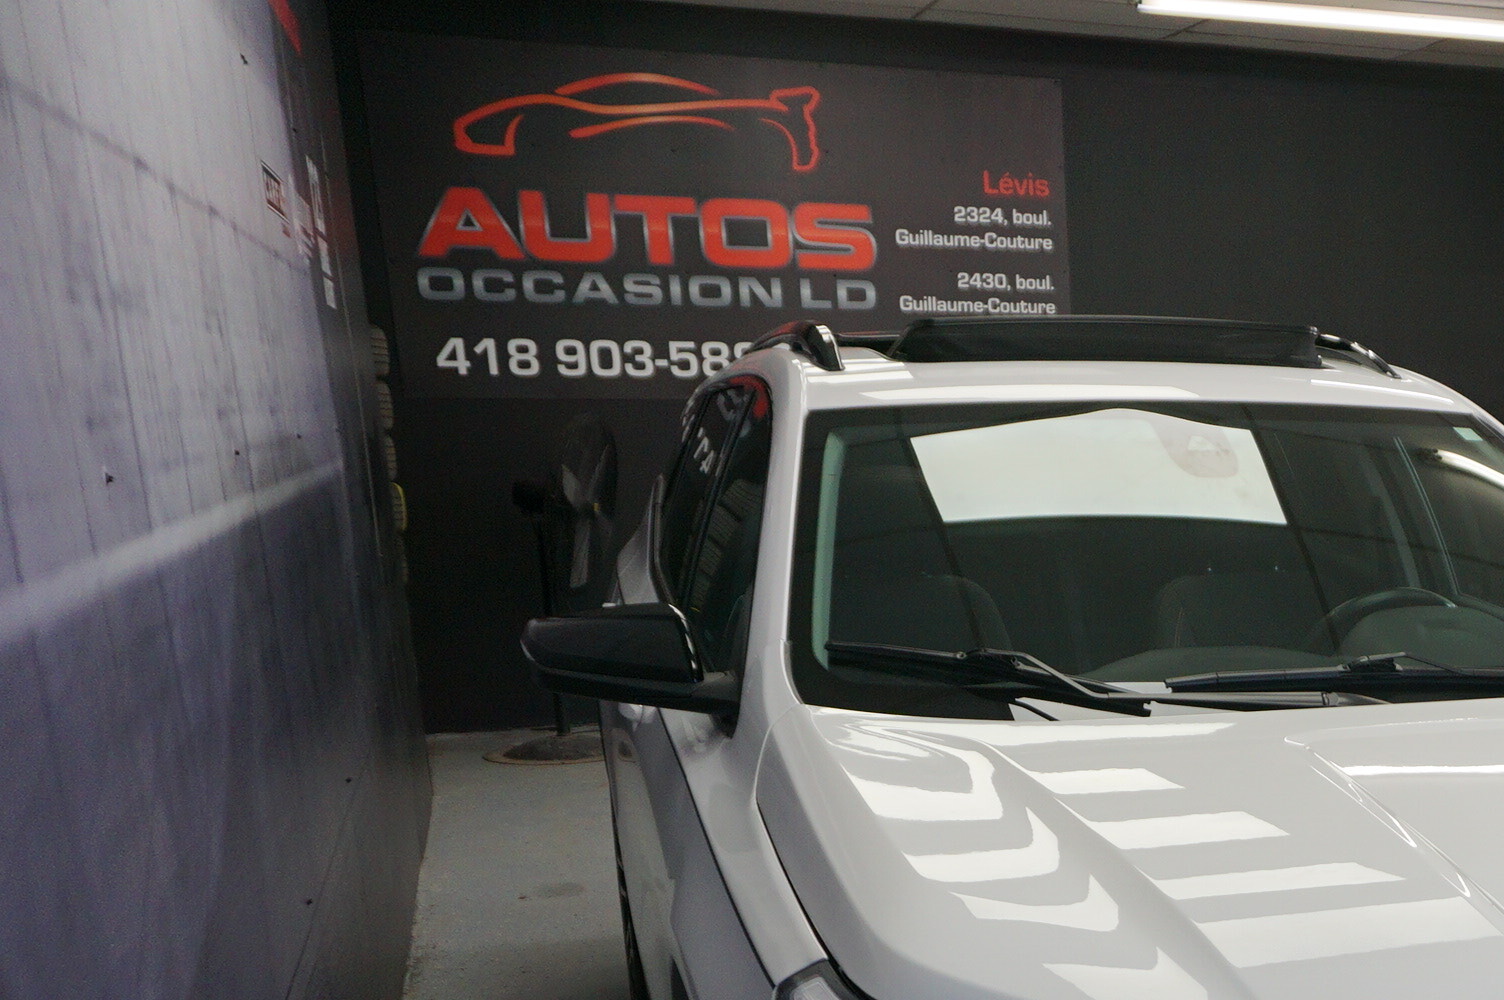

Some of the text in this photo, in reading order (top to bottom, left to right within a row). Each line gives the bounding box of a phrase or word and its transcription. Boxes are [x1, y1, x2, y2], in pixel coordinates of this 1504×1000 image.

[982, 170, 1050, 197] Lévis
[953, 206, 1053, 226] 2324, boul.
[419, 187, 877, 270] AUTOS
[895, 229, 1054, 250] Guillaume-Couture
[417, 267, 876, 310] OCCASION LD
[957, 272, 1055, 291] 2430, boul.
[899, 295, 1057, 315] Guillaume-Couture
[436, 337, 791, 379] 418 903-58
